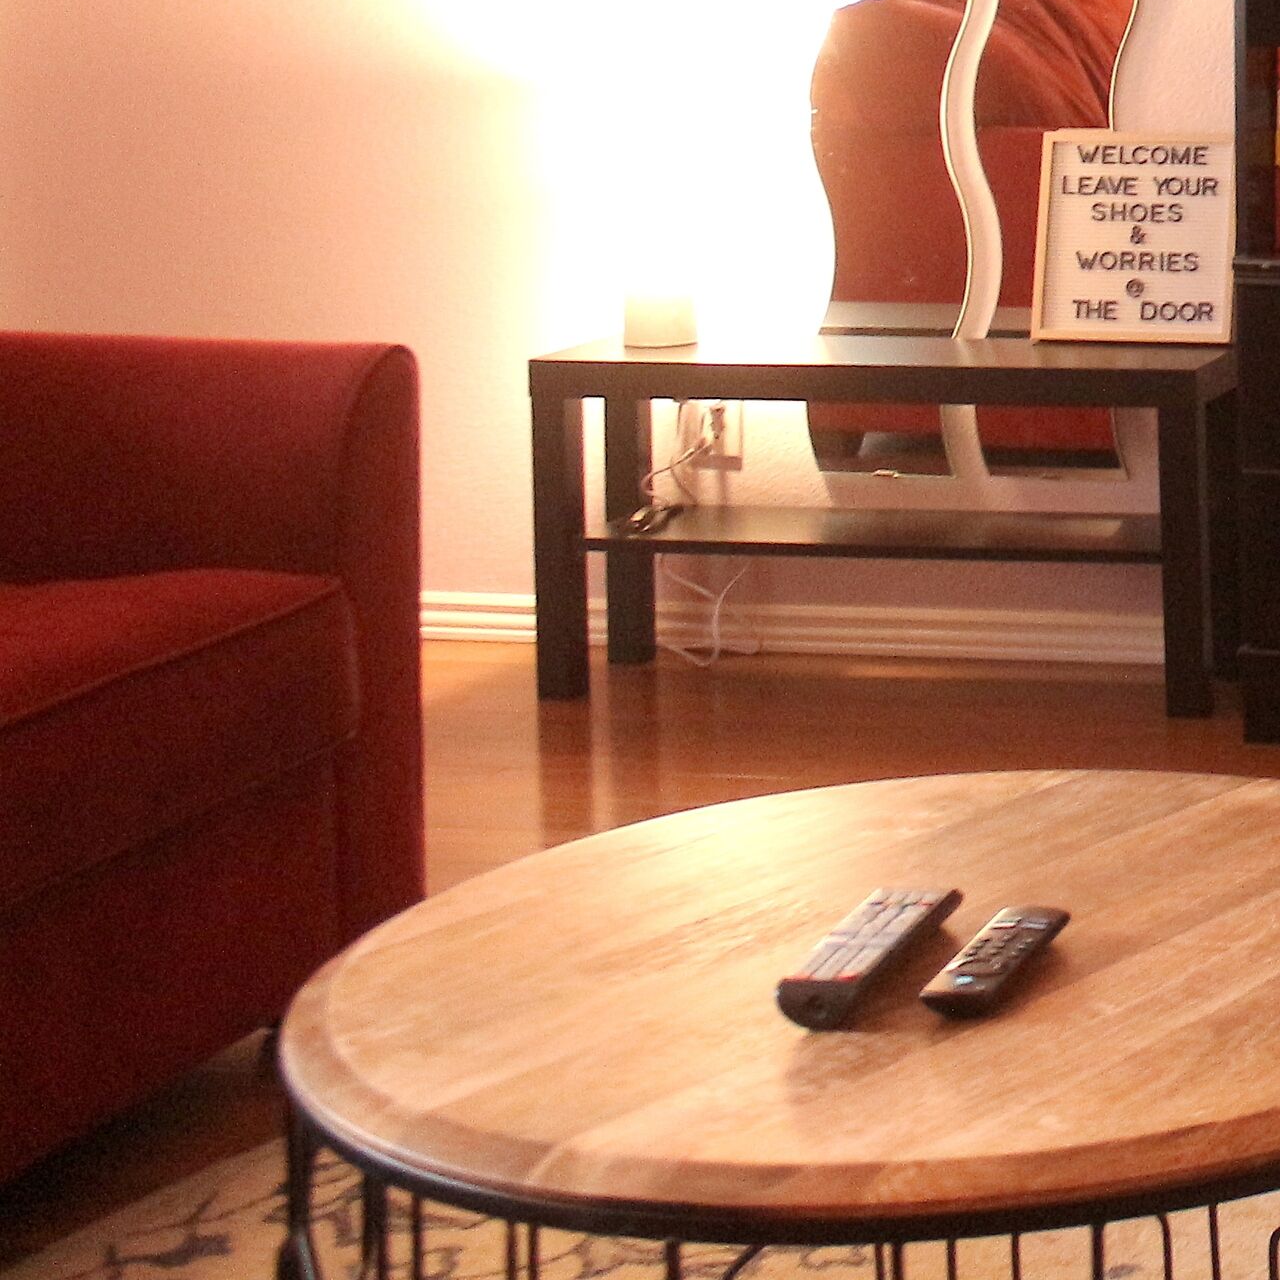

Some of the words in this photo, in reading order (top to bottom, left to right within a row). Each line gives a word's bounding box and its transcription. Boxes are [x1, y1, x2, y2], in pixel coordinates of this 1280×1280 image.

[1077, 145, 1210, 165] WELCOME
[1062, 175, 1138, 196] LEAVE
[1153, 176, 1219, 196] YOUR
[1092, 202, 1184, 222] SHOES
[1130, 225, 1146, 244] &
[1076, 250, 1200, 271] WORRIES
[1126, 278, 1145, 298] @
[1072, 300, 1119, 320] THE
[1140, 301, 1214, 321] DOOR
